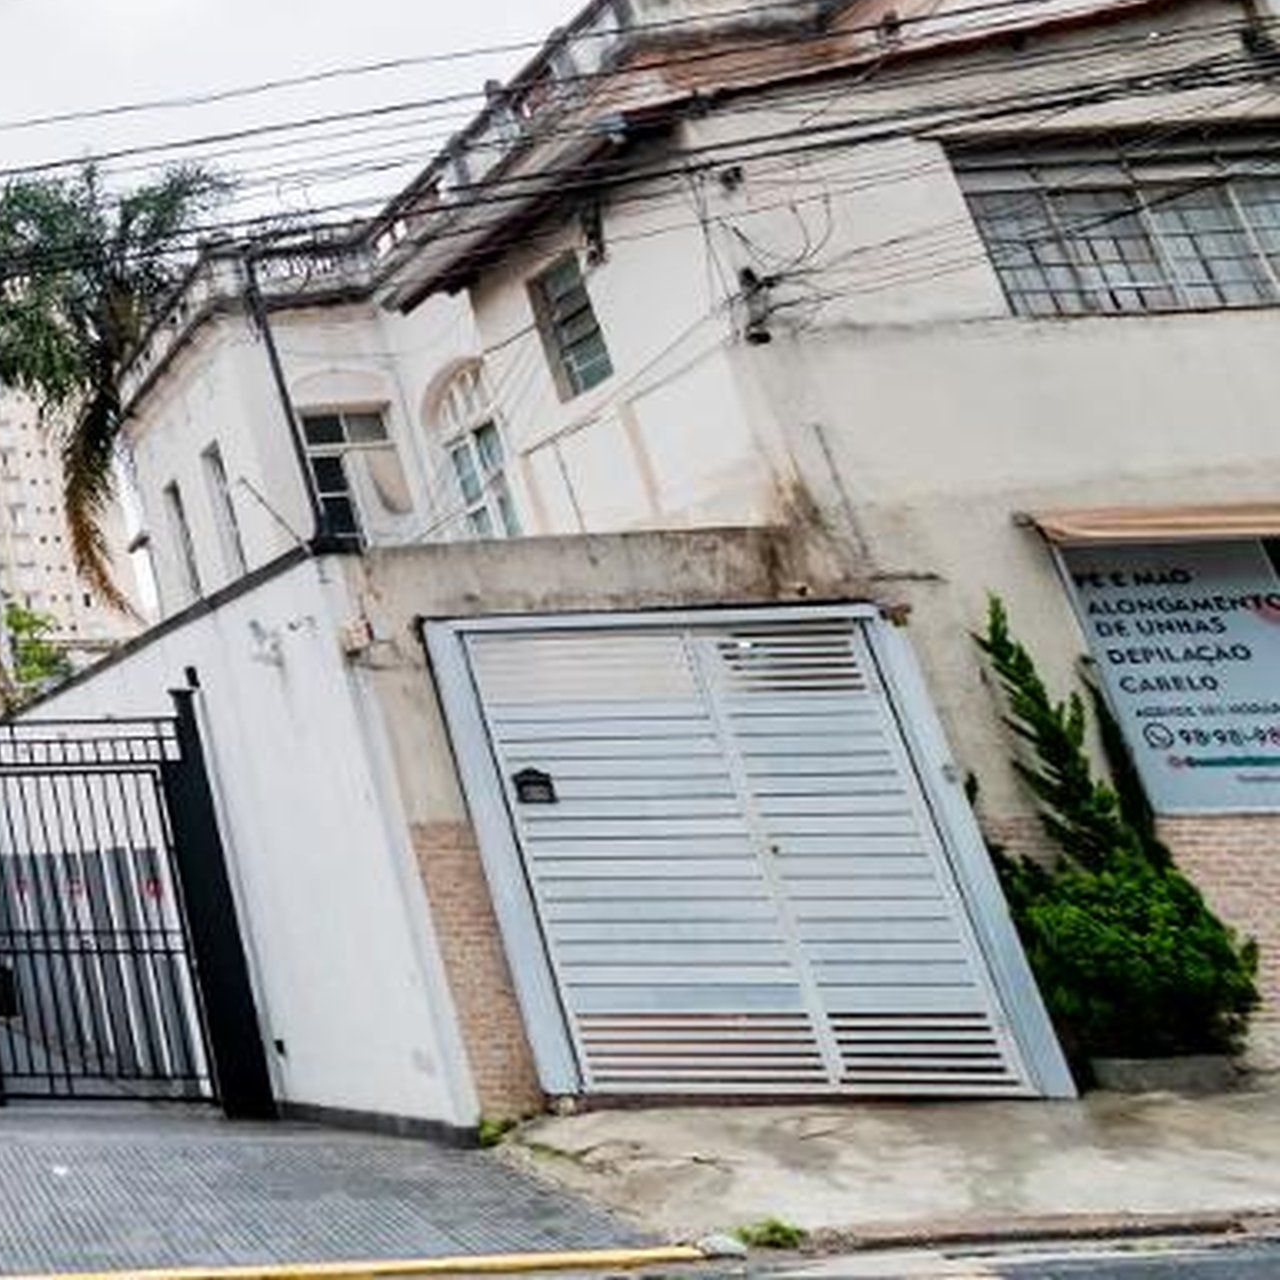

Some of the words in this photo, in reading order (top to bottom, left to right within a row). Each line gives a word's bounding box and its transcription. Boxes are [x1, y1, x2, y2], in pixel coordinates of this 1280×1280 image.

[1088, 592, 1280, 615] ALONGAMENTO
[1096, 621, 1130, 637] DE
[1136, 617, 1227, 636] UNHAS
[1119, 675, 1218, 694] CABELO
